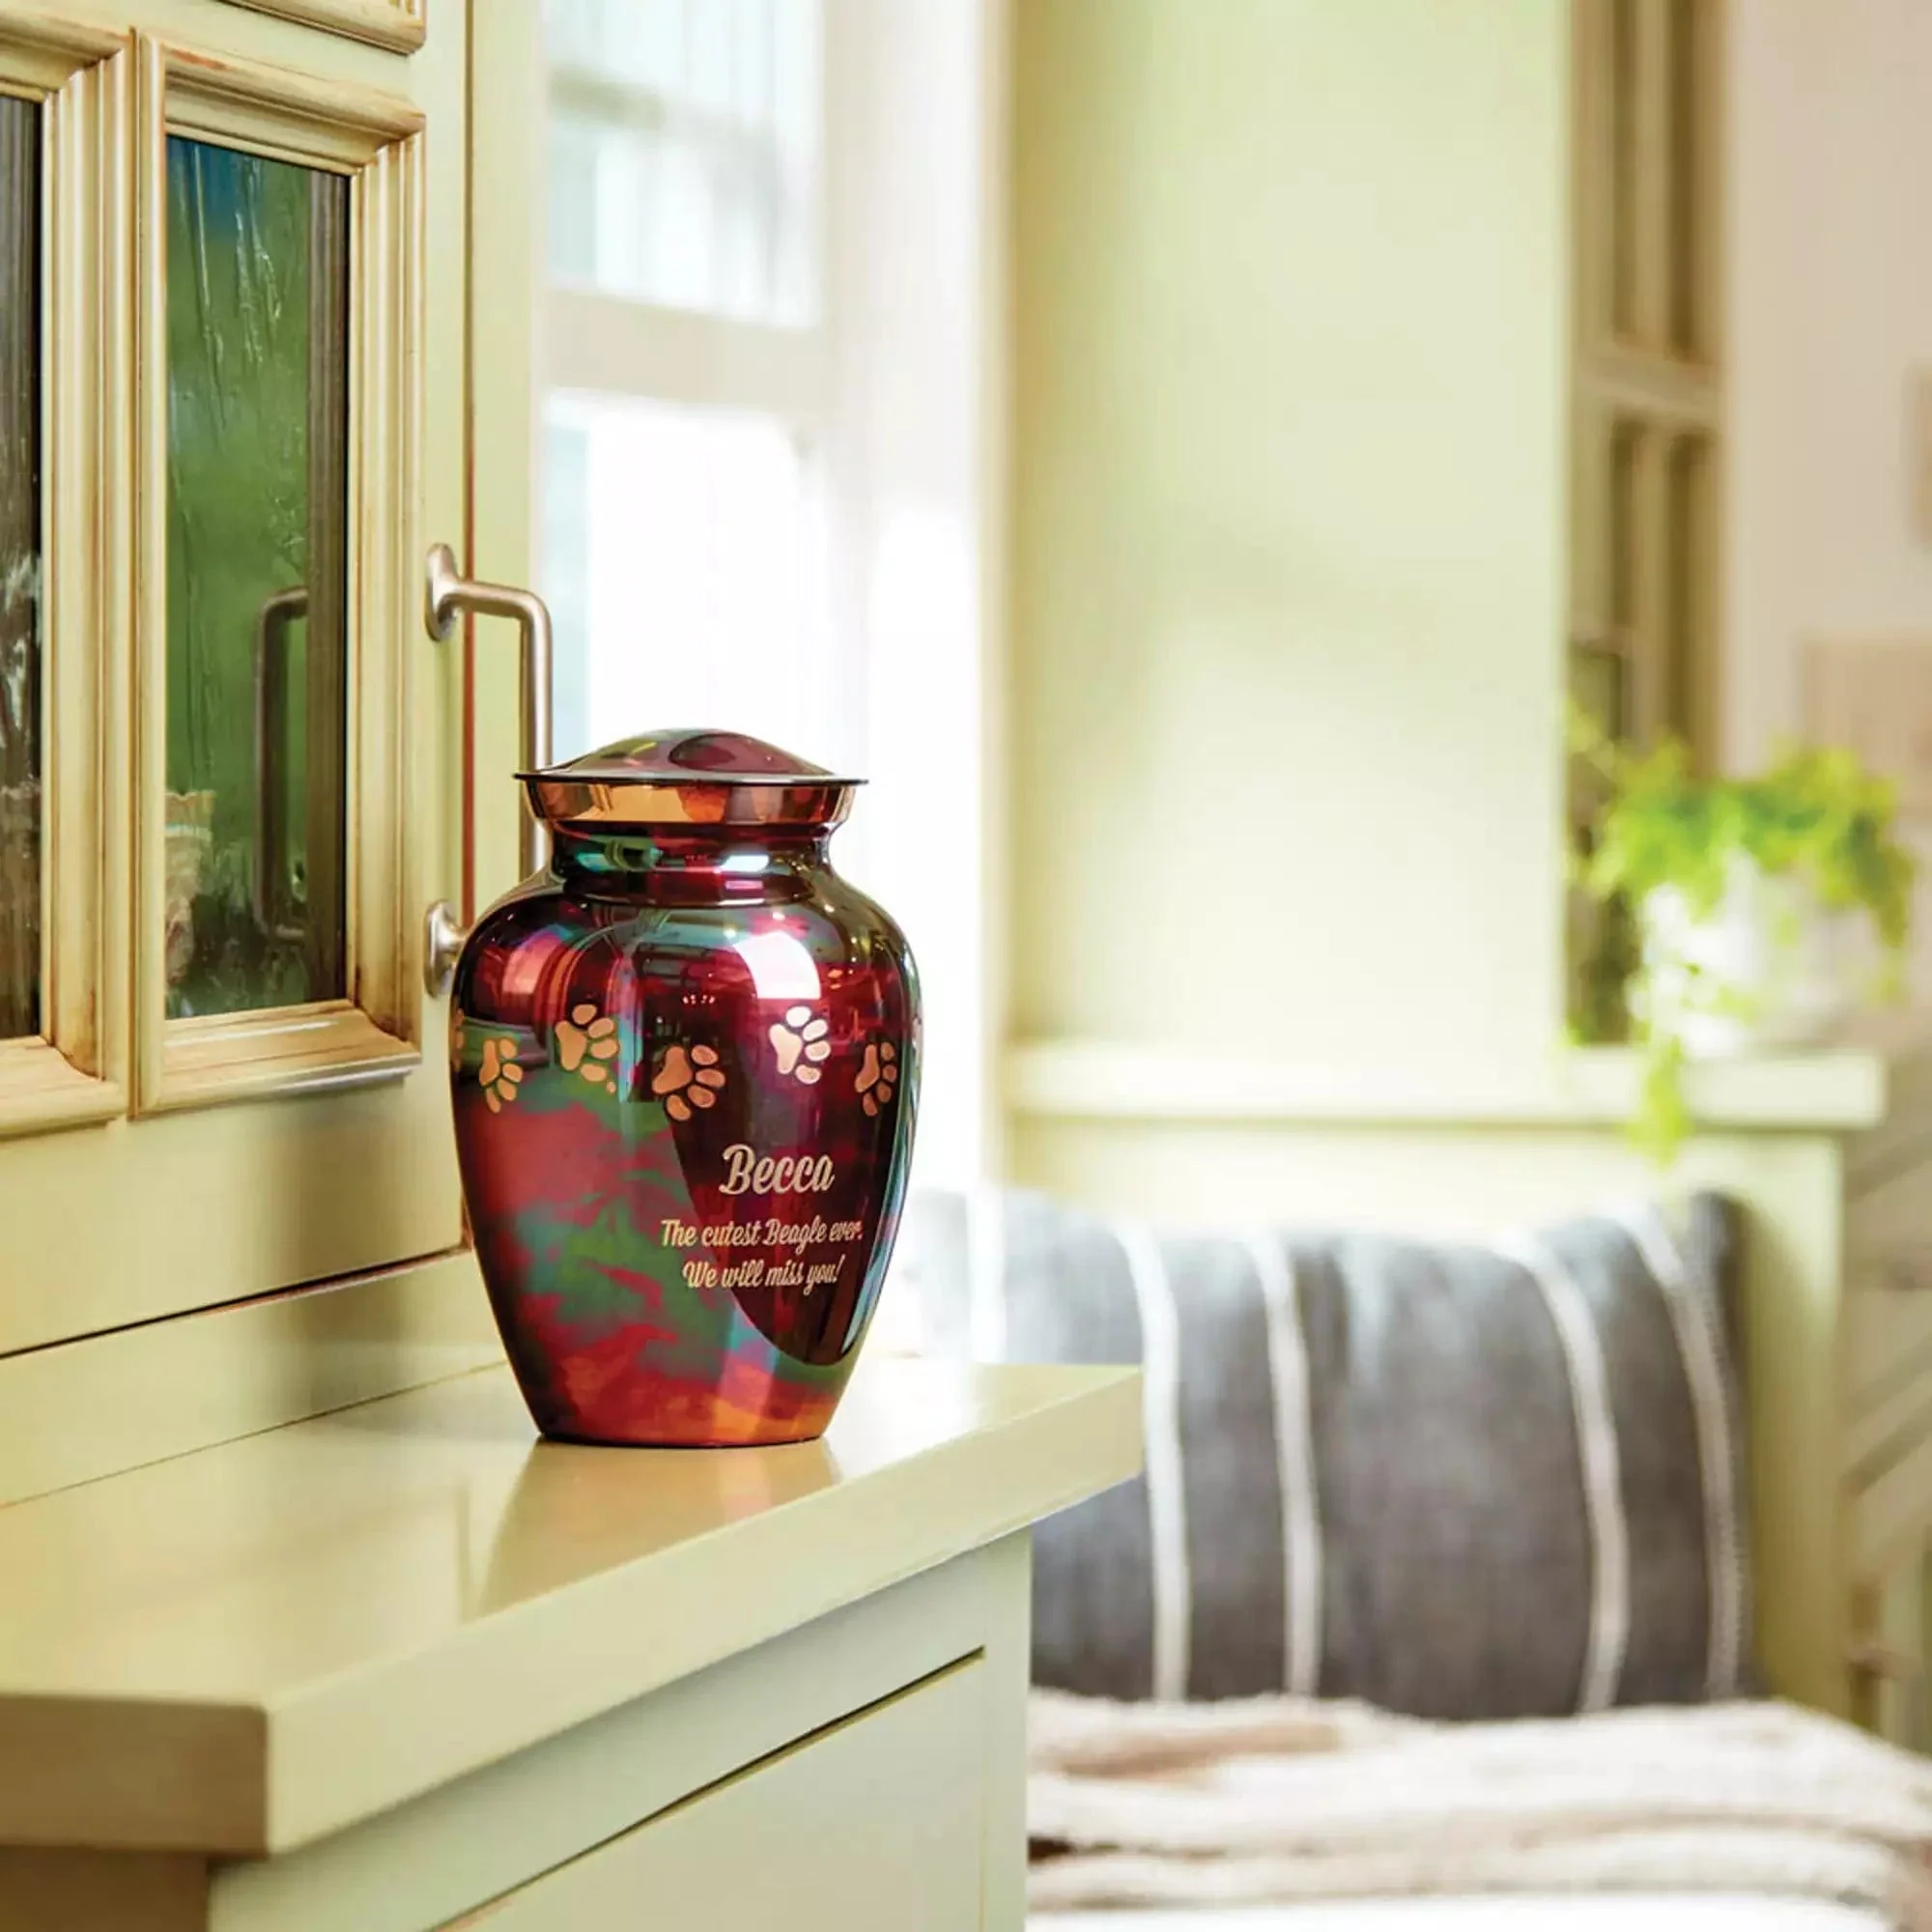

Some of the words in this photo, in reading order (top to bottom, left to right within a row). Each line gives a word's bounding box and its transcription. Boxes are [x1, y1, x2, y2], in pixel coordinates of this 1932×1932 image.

[719, 1144, 835, 1195] Becca
[661, 1219, 698, 1247] The
[701, 1220, 762, 1246] cutest
[762, 1214, 828, 1256] Beagle
[682, 1261, 719, 1288] We
[722, 1259, 764, 1288] will
[765, 1259, 805, 1287] miss
[804, 1254, 846, 1295] you!
